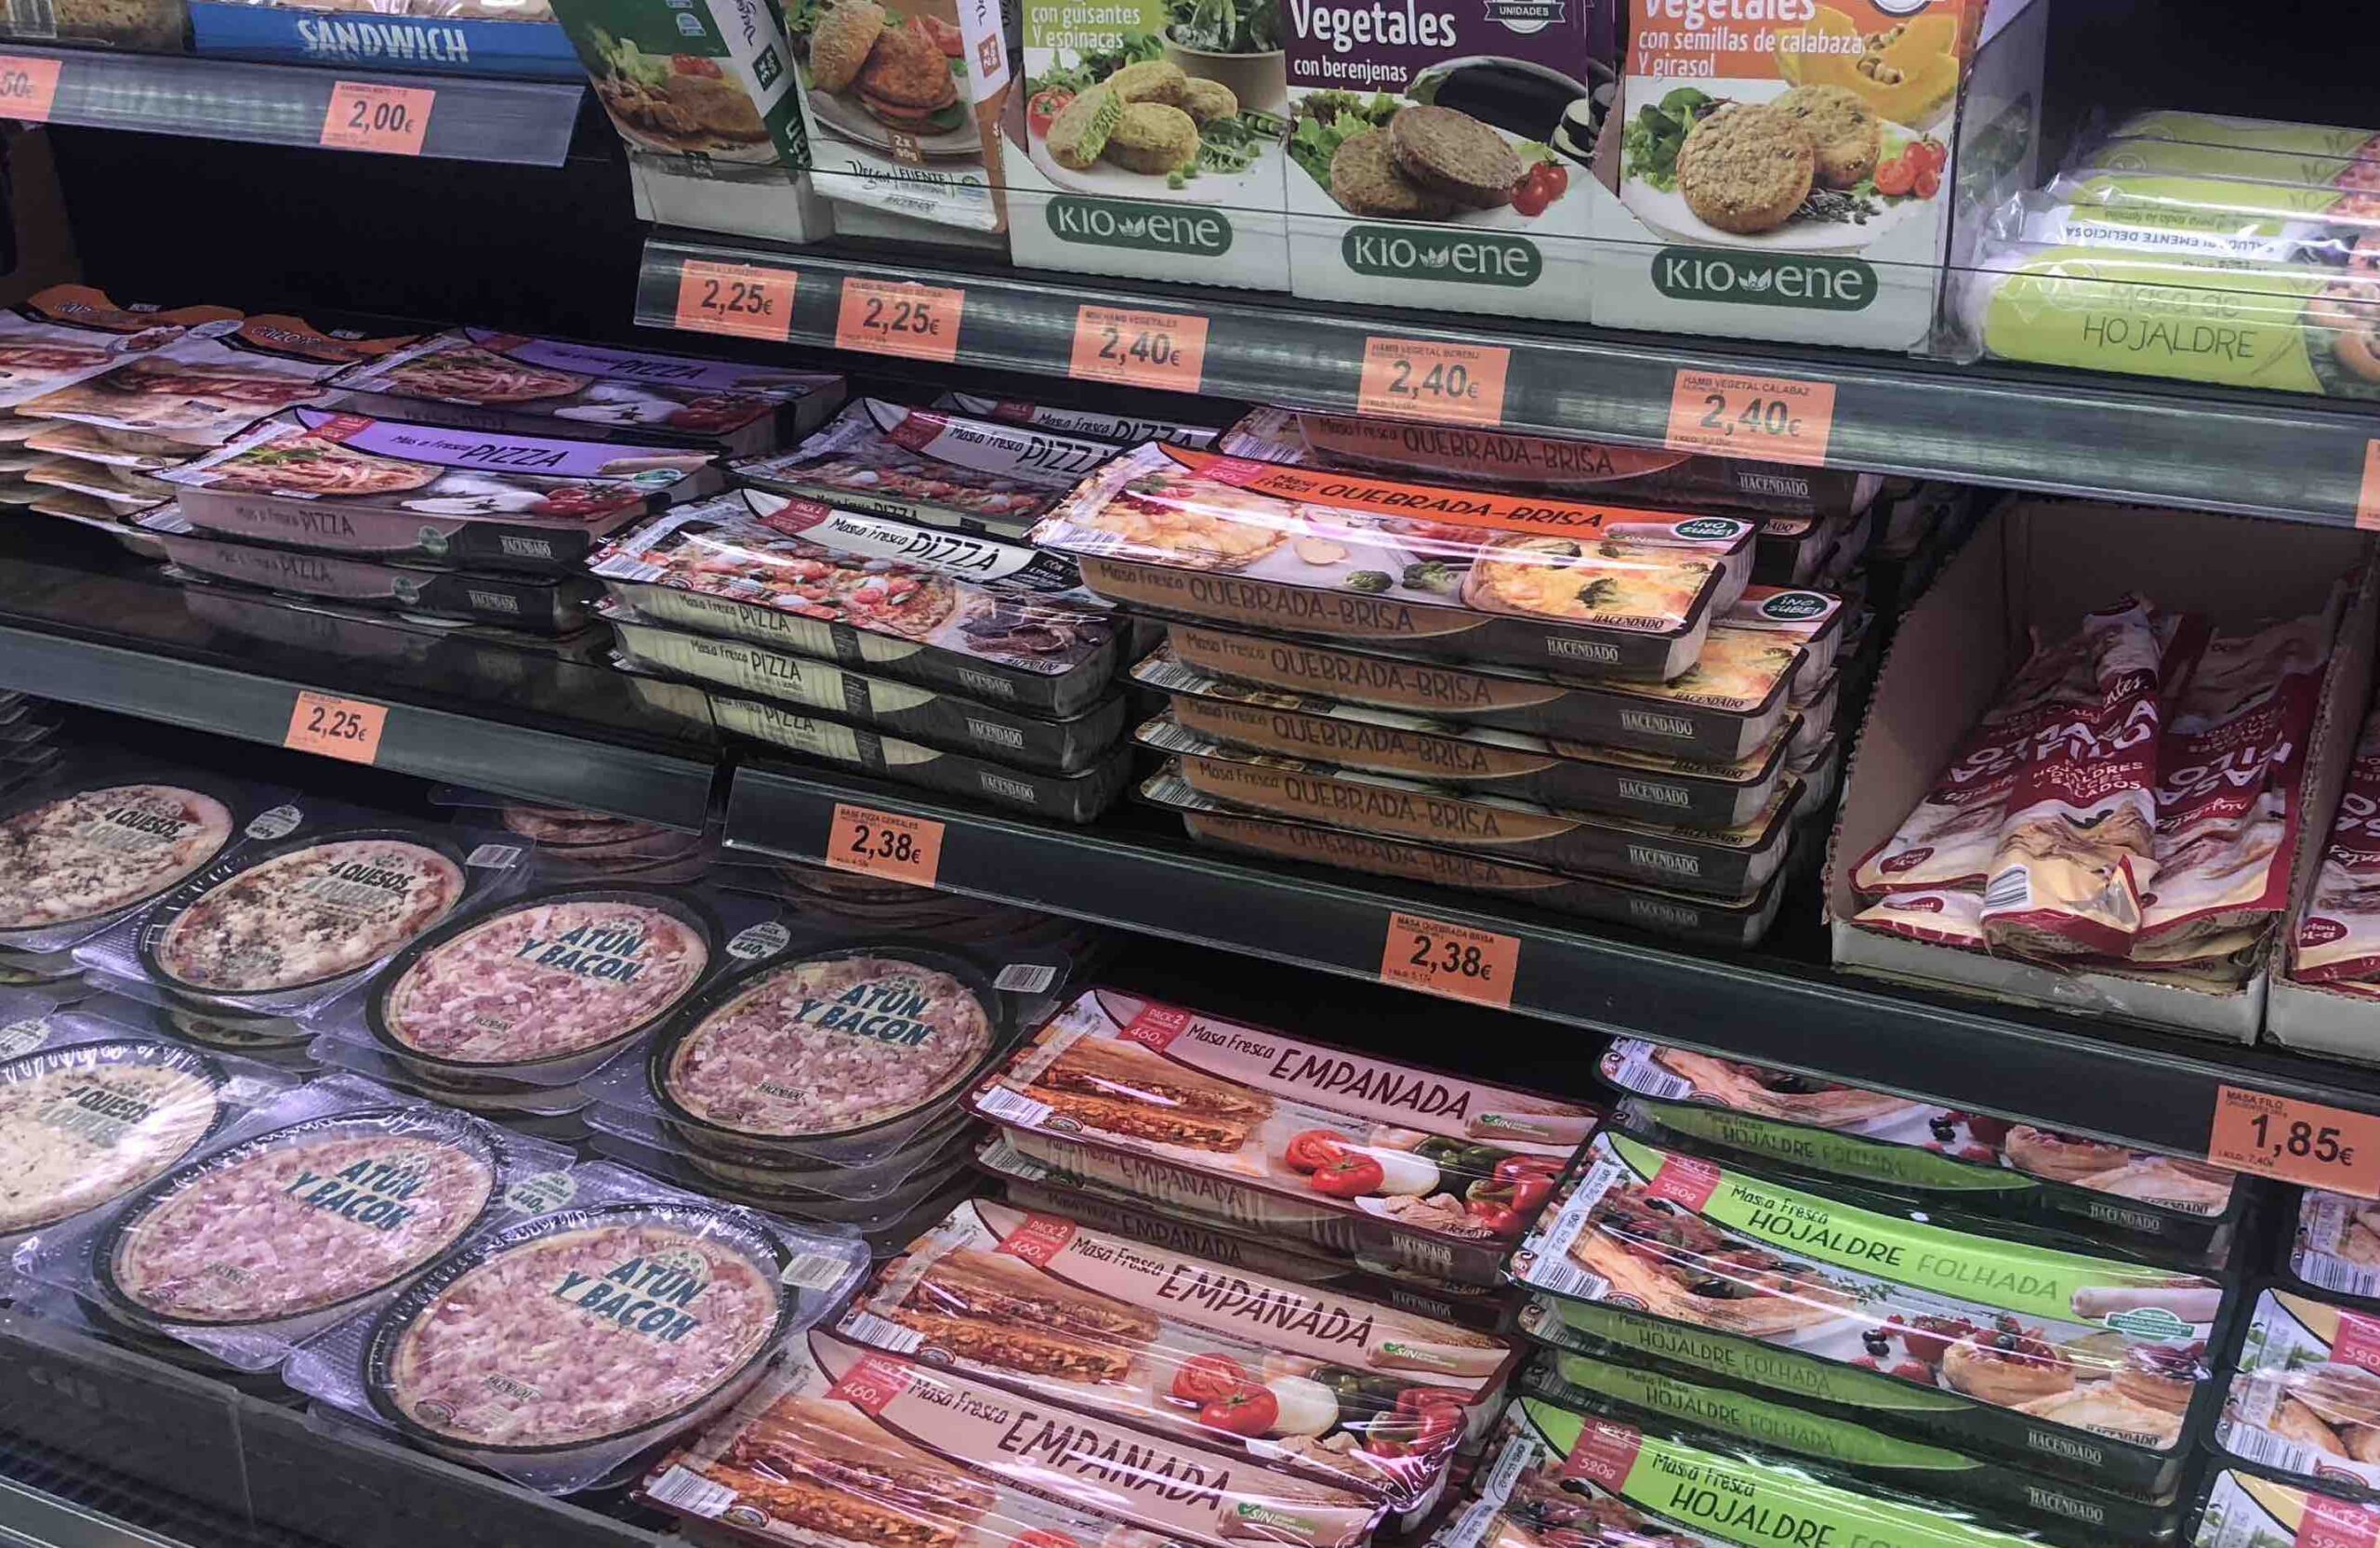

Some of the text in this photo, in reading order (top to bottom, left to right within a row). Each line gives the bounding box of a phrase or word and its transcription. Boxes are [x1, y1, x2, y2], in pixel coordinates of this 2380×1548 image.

[1031, 7, 1141, 29] con guisantes
[1293, 0, 1458, 52] Vegetales
[1499, 7, 1550, 17] UNIDADES
[298, 18, 469, 62] SANDWICH
[1033, 31, 1125, 52] Y espinacas
[1639, 26, 1863, 55] con semillas de calabaza
[1294, 55, 1408, 84] con berenjenas
[1638, 54, 1714, 78] Y girasol
[349, 99, 416, 134] 2,00€
[701, 278, 774, 316] 2,25€
[862, 296, 941, 336] 2,25€
[1099, 327, 1182, 366] 2,40€
[2082, 316, 2258, 359] HOJALDRE
[1389, 360, 1480, 400] 2,40€
[1700, 393, 1803, 438] 2,40€
[458, 443, 569, 468] PIZZA
[1404, 429, 1616, 477] QUEBRADA-BRISA
[1739, 475, 1809, 496] HACENDADO
[300, 510, 356, 537] PIZZA
[1319, 483, 1604, 528] QUEBRADA-BRISA
[900, 531, 1003, 573] PIZZA
[739, 604, 791, 633] PIZZA
[1190, 576, 1415, 633] QUEBRADA-BRISA
[750, 652, 802, 682] PIZZA
[1547, 638, 1620, 663] HACENDADO
[1272, 648, 1494, 704] QUEBRADA-BRISA
[307, 707, 367, 742] 2,25€
[968, 719, 1025, 748] HACENDADO
[1272, 714, 1490, 773] QUEBRADA-BRISA
[1620, 712, 1694, 737] HACENDADO
[1284, 777, 1501, 837] QUEBRADA-BRISA
[1619, 779, 1690, 807] HACENDADO
[104, 808, 188, 837] 4 QUESOS
[851, 825, 922, 865] 2,38€
[1630, 848, 1701, 876] HACENDADO
[326, 862, 416, 893] 4 QUESOS
[515, 938, 645, 983] Y BACON
[1409, 935, 1493, 981] 2,38€
[794, 999, 936, 1047] Y BACON
[1174, 1013, 1186, 1025] 2
[1187, 1023, 1472, 1121] Masa Fresca EMPANADA
[2227, 1090, 2257, 1104] MASA
[2259, 1096, 2284, 1110] FILO
[1722, 1125, 1814, 1158] HOJALDRE
[2251, 1113, 2355, 1167] 1,85€
[283, 1171, 414, 1233] Y BACON
[1780, 1197, 1829, 1225] Fresca
[2090, 1204, 2161, 1232] HACENDADO
[1057, 1225, 1068, 1237] 2
[1121, 1214, 1243, 1262] EMPANADA
[1748, 1209, 2059, 1302] HOJALDRE FOLHADA
[551, 1270, 703, 1343] Y BACON
[1069, 1236, 1112, 1262] Masa
[1156, 1264, 1375, 1349] EMPANADA
[1638, 1330, 1831, 1394] HOJALDRE FOLHADA
[1646, 1385, 1836, 1455] HOJALDRE FOLHADA
[906, 1378, 1232, 1513] Masa Fresca EMPANADA
[2029, 1430, 2103, 1463] HACENDADO
[1703, 1466, 1755, 1497] Fresca
[1669, 1483, 1837, 1548] HOJALDRE
[2029, 1488, 2104, 1523] HACENDADO
